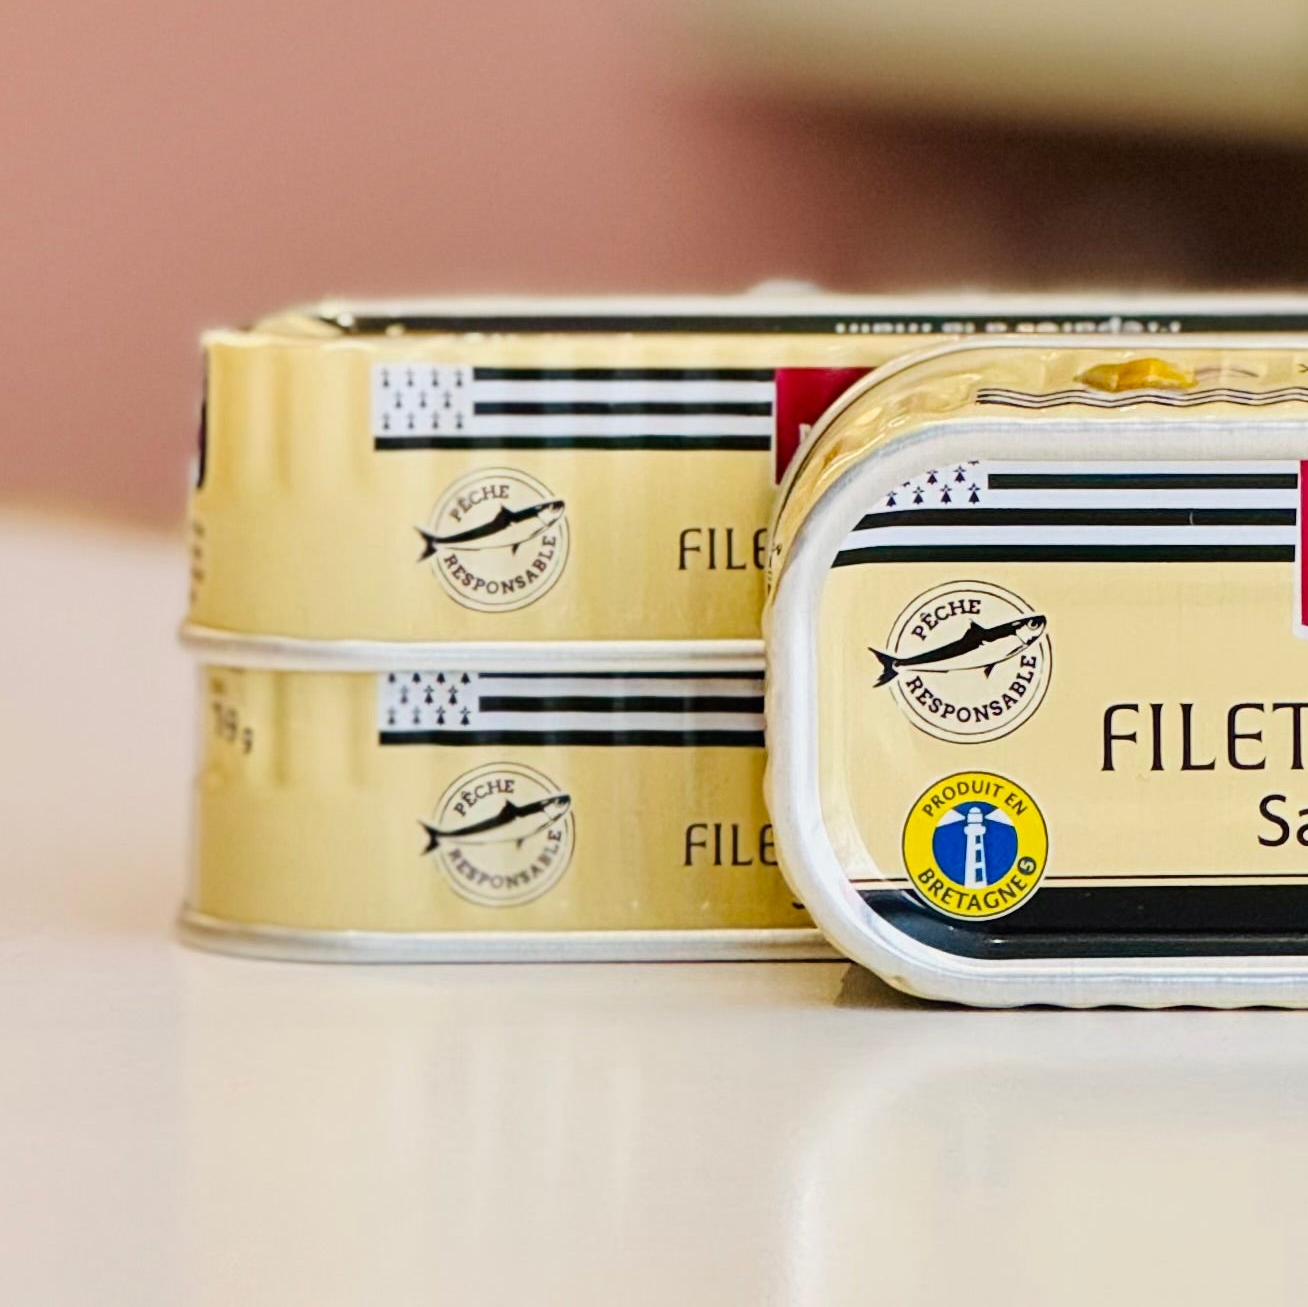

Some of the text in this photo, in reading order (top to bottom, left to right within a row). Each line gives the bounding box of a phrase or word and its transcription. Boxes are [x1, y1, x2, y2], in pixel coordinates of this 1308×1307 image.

[444, 535, 556, 594] RESPONSABLE
[678, 527, 768, 570] FILE
[911, 598, 982, 641] PÊCHE
[906, 654, 1038, 723] RESPONSABLE
[453, 778, 516, 817] PÊCHE
[922, 780, 1028, 817] PRODUIT EN
[449, 830, 562, 889] RESPONSABLE
[683, 823, 778, 866] FILE
[918, 867, 1028, 912] BRETAGNE
